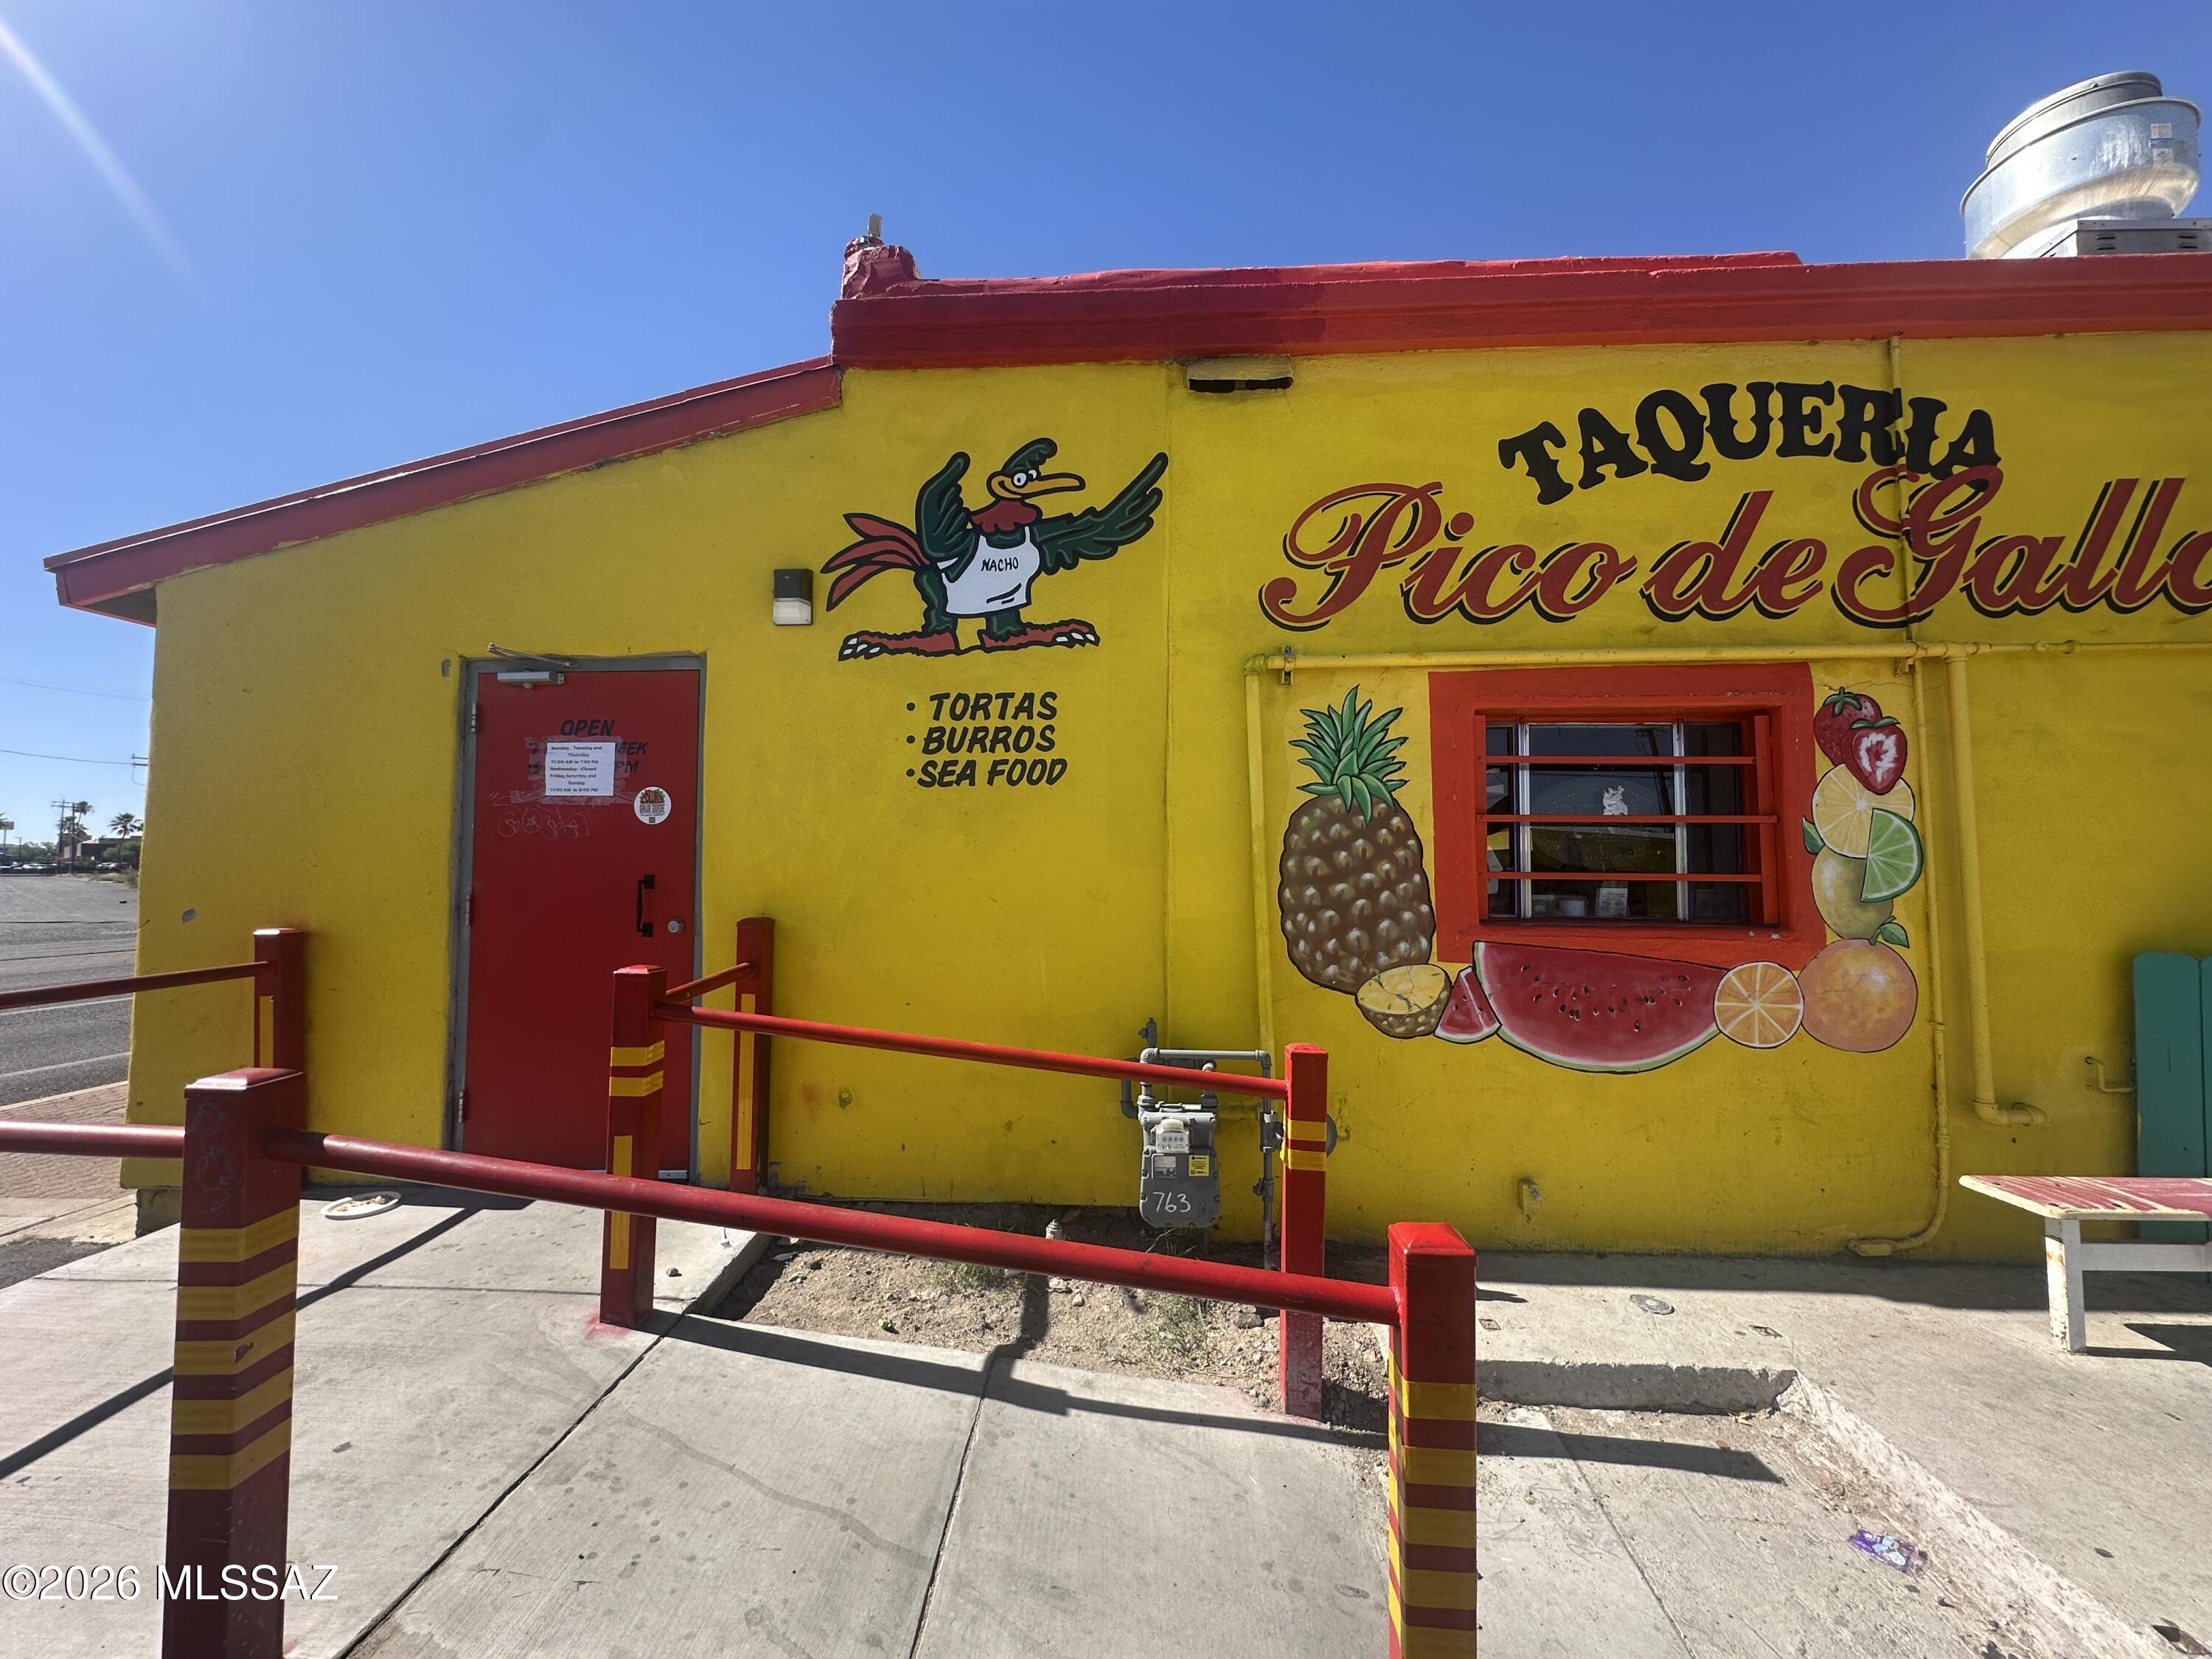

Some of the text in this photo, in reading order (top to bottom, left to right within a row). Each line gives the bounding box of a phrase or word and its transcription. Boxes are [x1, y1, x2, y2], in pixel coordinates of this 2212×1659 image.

[1498, 380, 2001, 505] TAQUERIA
[981, 557, 1018, 571] NACHO
[1259, 481, 1638, 633] Pico
[1641, 490, 1828, 622] de
[930, 692, 1057, 721] TORTAS
[560, 719, 615, 736] OPEN
[922, 724, 1056, 754] BURROS
[616, 741, 649, 755] EEK
[917, 758, 1068, 787] SEA FOOD
[1152, 1192, 1192, 1213] 763
